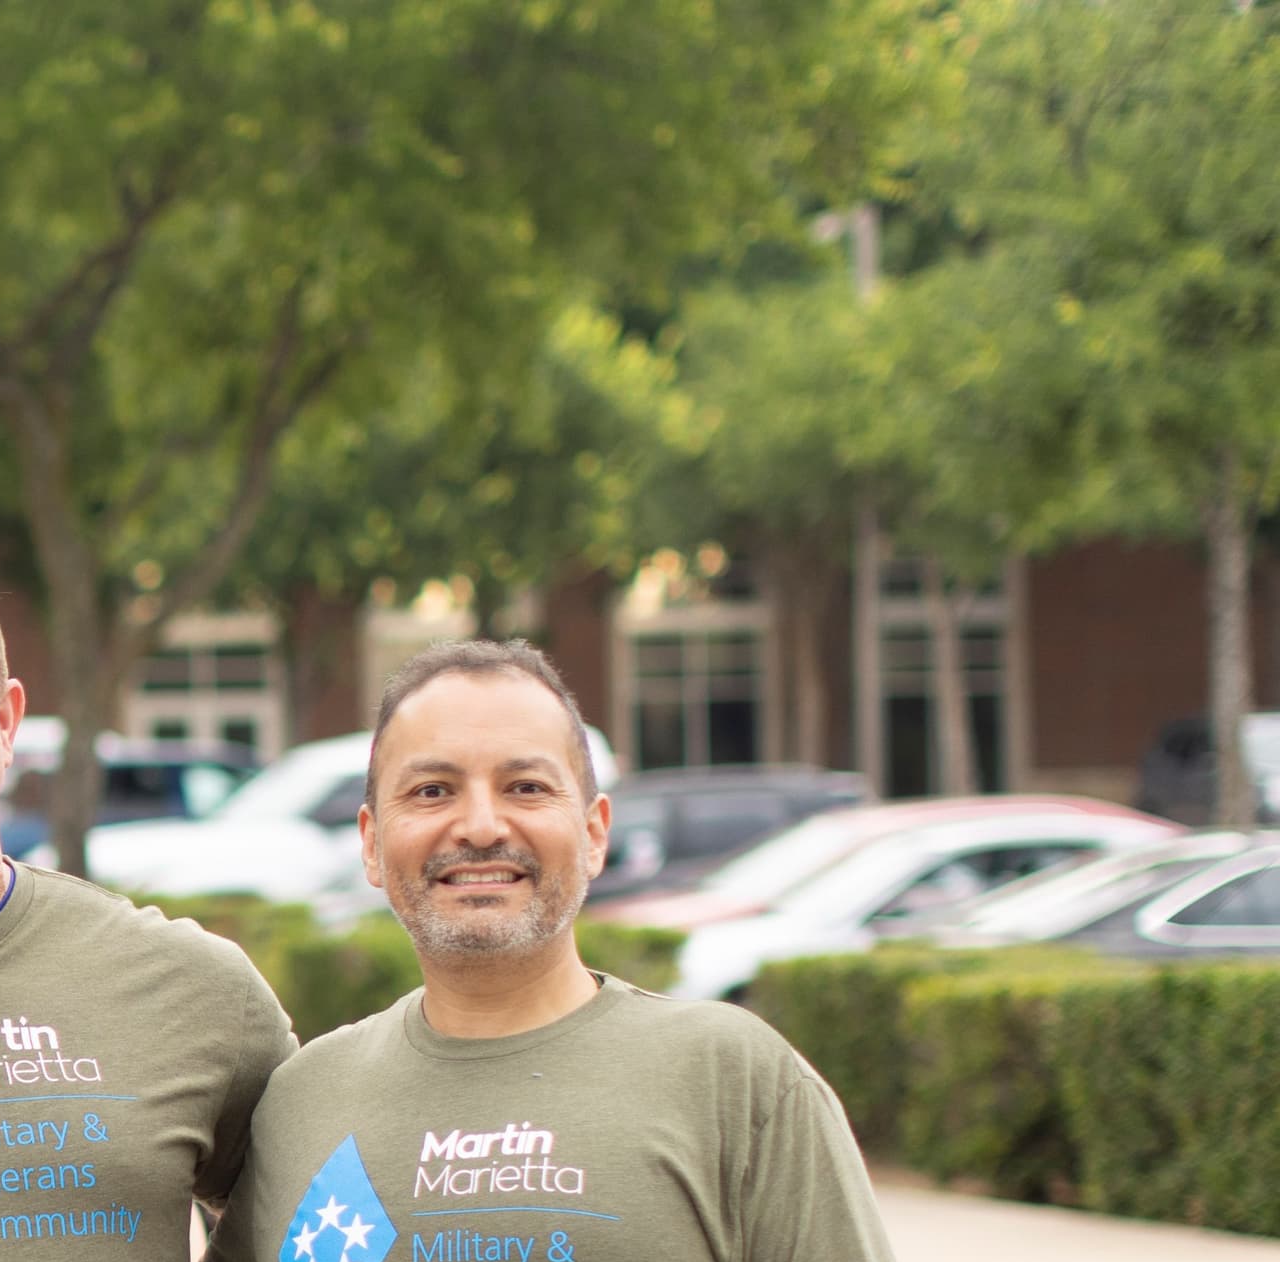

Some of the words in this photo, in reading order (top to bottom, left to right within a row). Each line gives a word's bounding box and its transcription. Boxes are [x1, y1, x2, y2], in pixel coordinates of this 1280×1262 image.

[82, 1112, 110, 1142] &
[419, 1121, 554, 1163] Martin
[413, 1157, 584, 1199] Marietta
